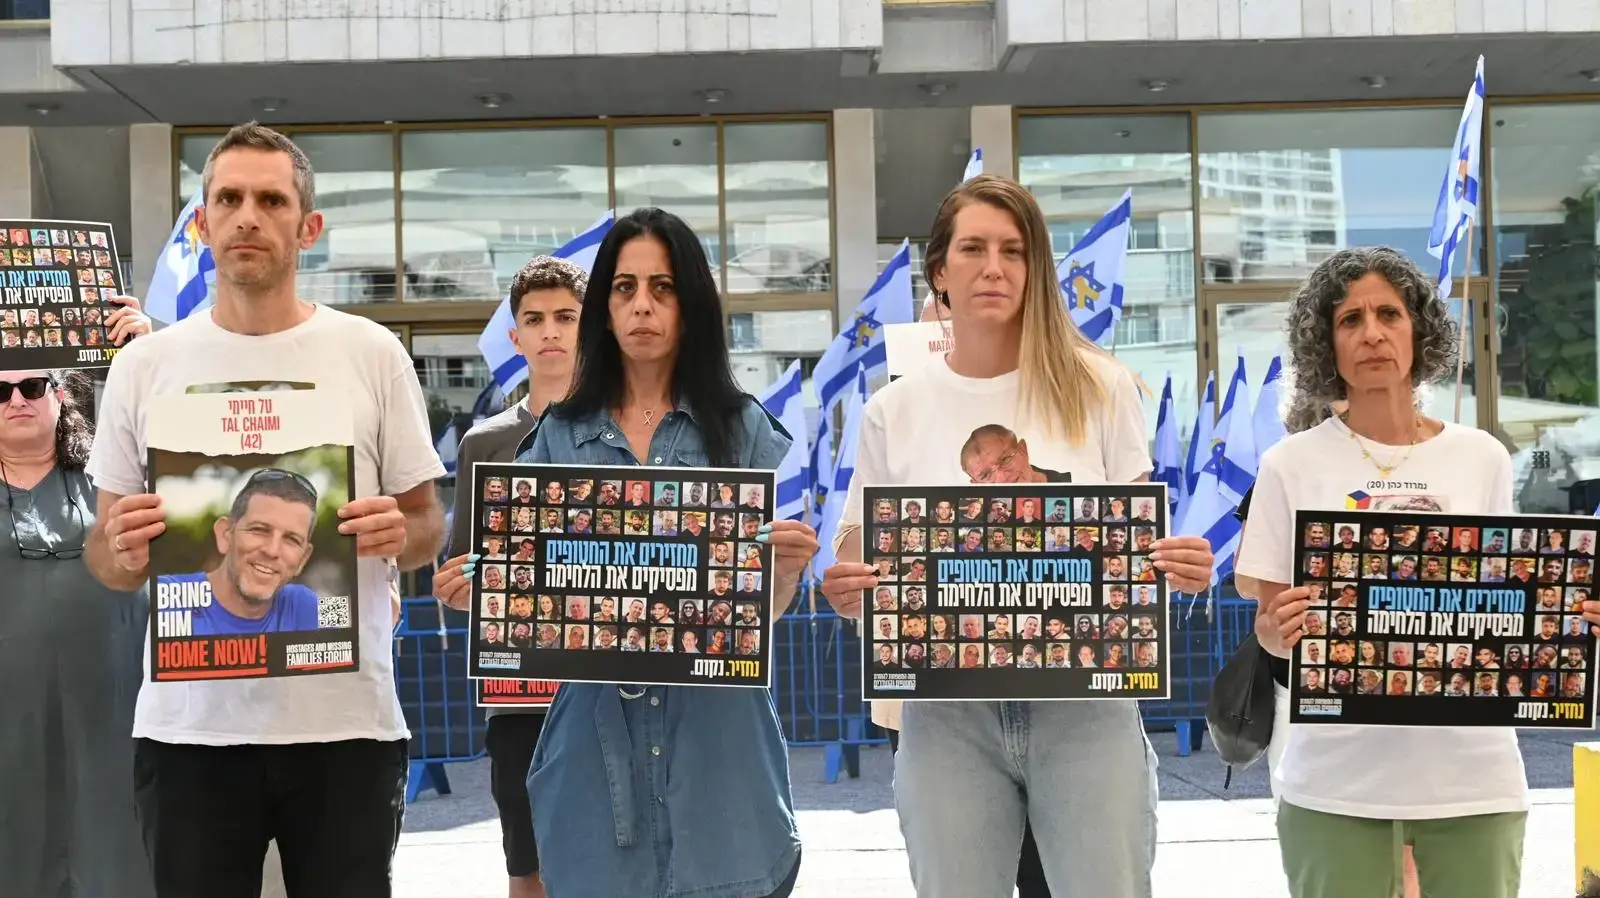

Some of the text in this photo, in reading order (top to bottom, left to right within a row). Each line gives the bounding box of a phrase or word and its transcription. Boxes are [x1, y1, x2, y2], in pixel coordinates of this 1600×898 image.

[8, 270, 26, 287] את
[27, 270, 71, 287] מחזירים
[5, 287, 23, 304] את
[25, 287, 73, 306] מפסיקים
[77, 349, 101, 362] נקום.
[228, 398, 272, 415] טל חיימי
[221, 416, 280, 432] TAL CHAIMI
[241, 433, 262, 450] (42)
[1366, 481, 1385, 489] (20)
[1388, 481, 1402, 489] כהן
[546, 539, 697, 567] מחזירים את החטופים
[545, 563, 697, 594] מפסיקים את הלחימה
[937, 559, 1092, 583] מחזירים את החטופים
[157, 580, 212, 609] BRING
[937, 581, 1092, 610] מפסיקים את הלחימה
[1368, 586, 1526, 613] מחזירים את החטופים
[157, 610, 192, 638] HIM
[1367, 608, 1524, 640] מפסיקים את הלחימה
[158, 633, 268, 668] HOME NOW!
[286, 640, 352, 654] HOSTAGES AND MISSING
[287, 649, 353, 666] FAMILIES FORUM
[690, 659, 760, 678] נחזיר. נקום.
[483, 679, 523, 694] HOME
[1087, 672, 1159, 692] נחזיר. נקום.
[1514, 702, 1585, 720] נחזיר. נקום.
